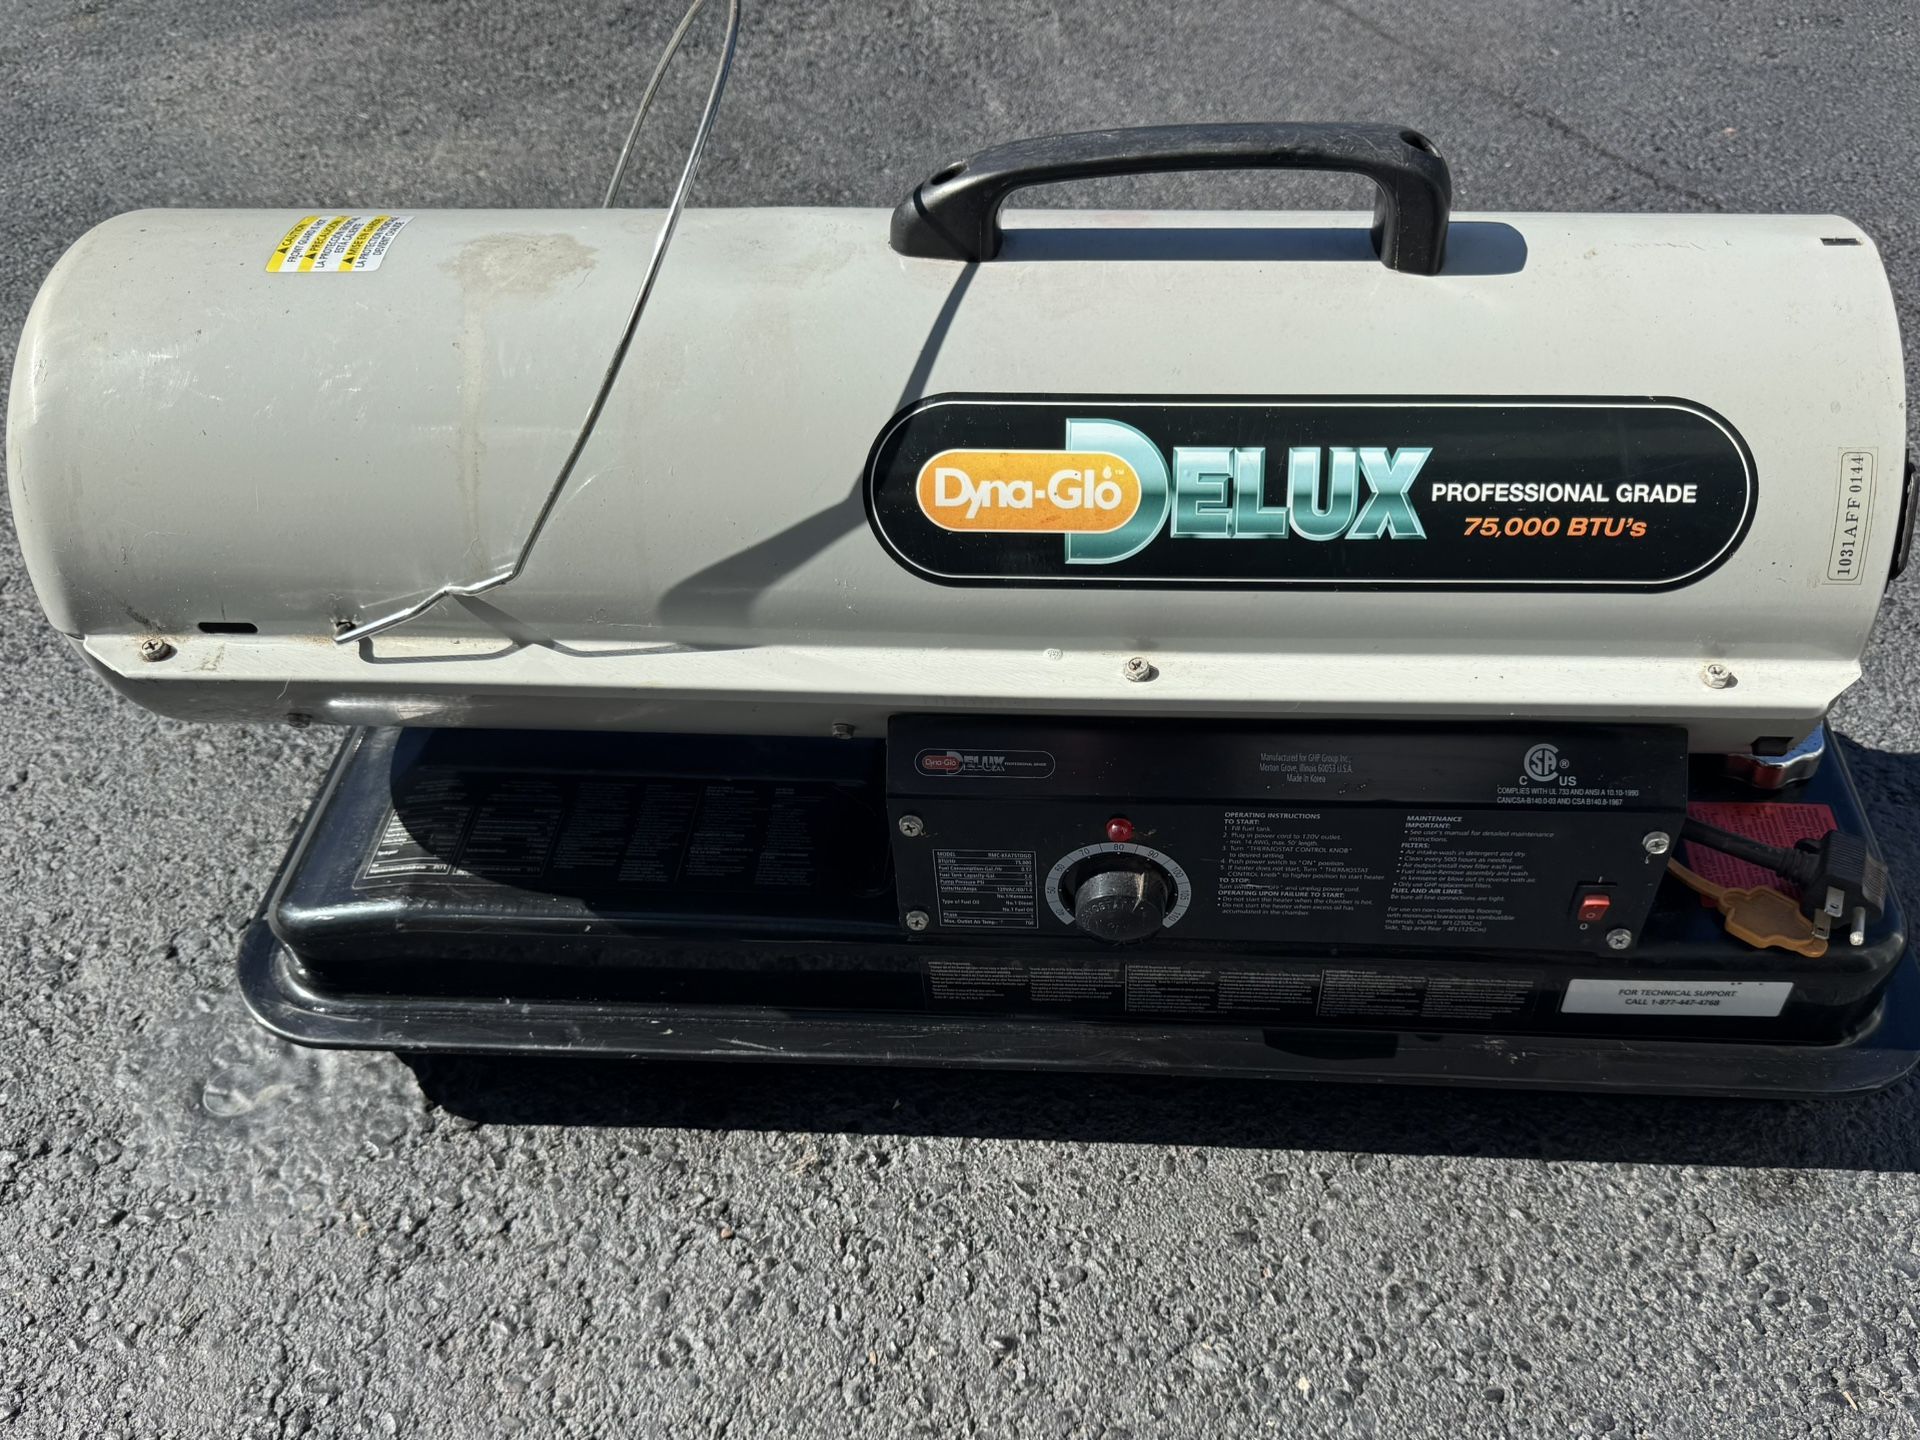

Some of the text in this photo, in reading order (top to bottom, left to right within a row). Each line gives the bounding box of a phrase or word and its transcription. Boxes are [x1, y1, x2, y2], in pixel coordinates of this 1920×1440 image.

[935, 418, 1432, 564] Dyna-Glo DELUX
[1432, 483, 1697, 503] PROFESSIONAL GRADE
[1838, 456, 1864, 575] 1031AFF 0144
[1463, 517, 1648, 539] 75,000 BTU's
[1310, 775, 1326, 783] Korea
[1519, 776, 1576, 786] C US
[1079, 848, 1090, 856] 70
[1148, 850, 1159, 858] 90
[1173, 867, 1183, 878] 100
[1169, 912, 1181, 922] 110
